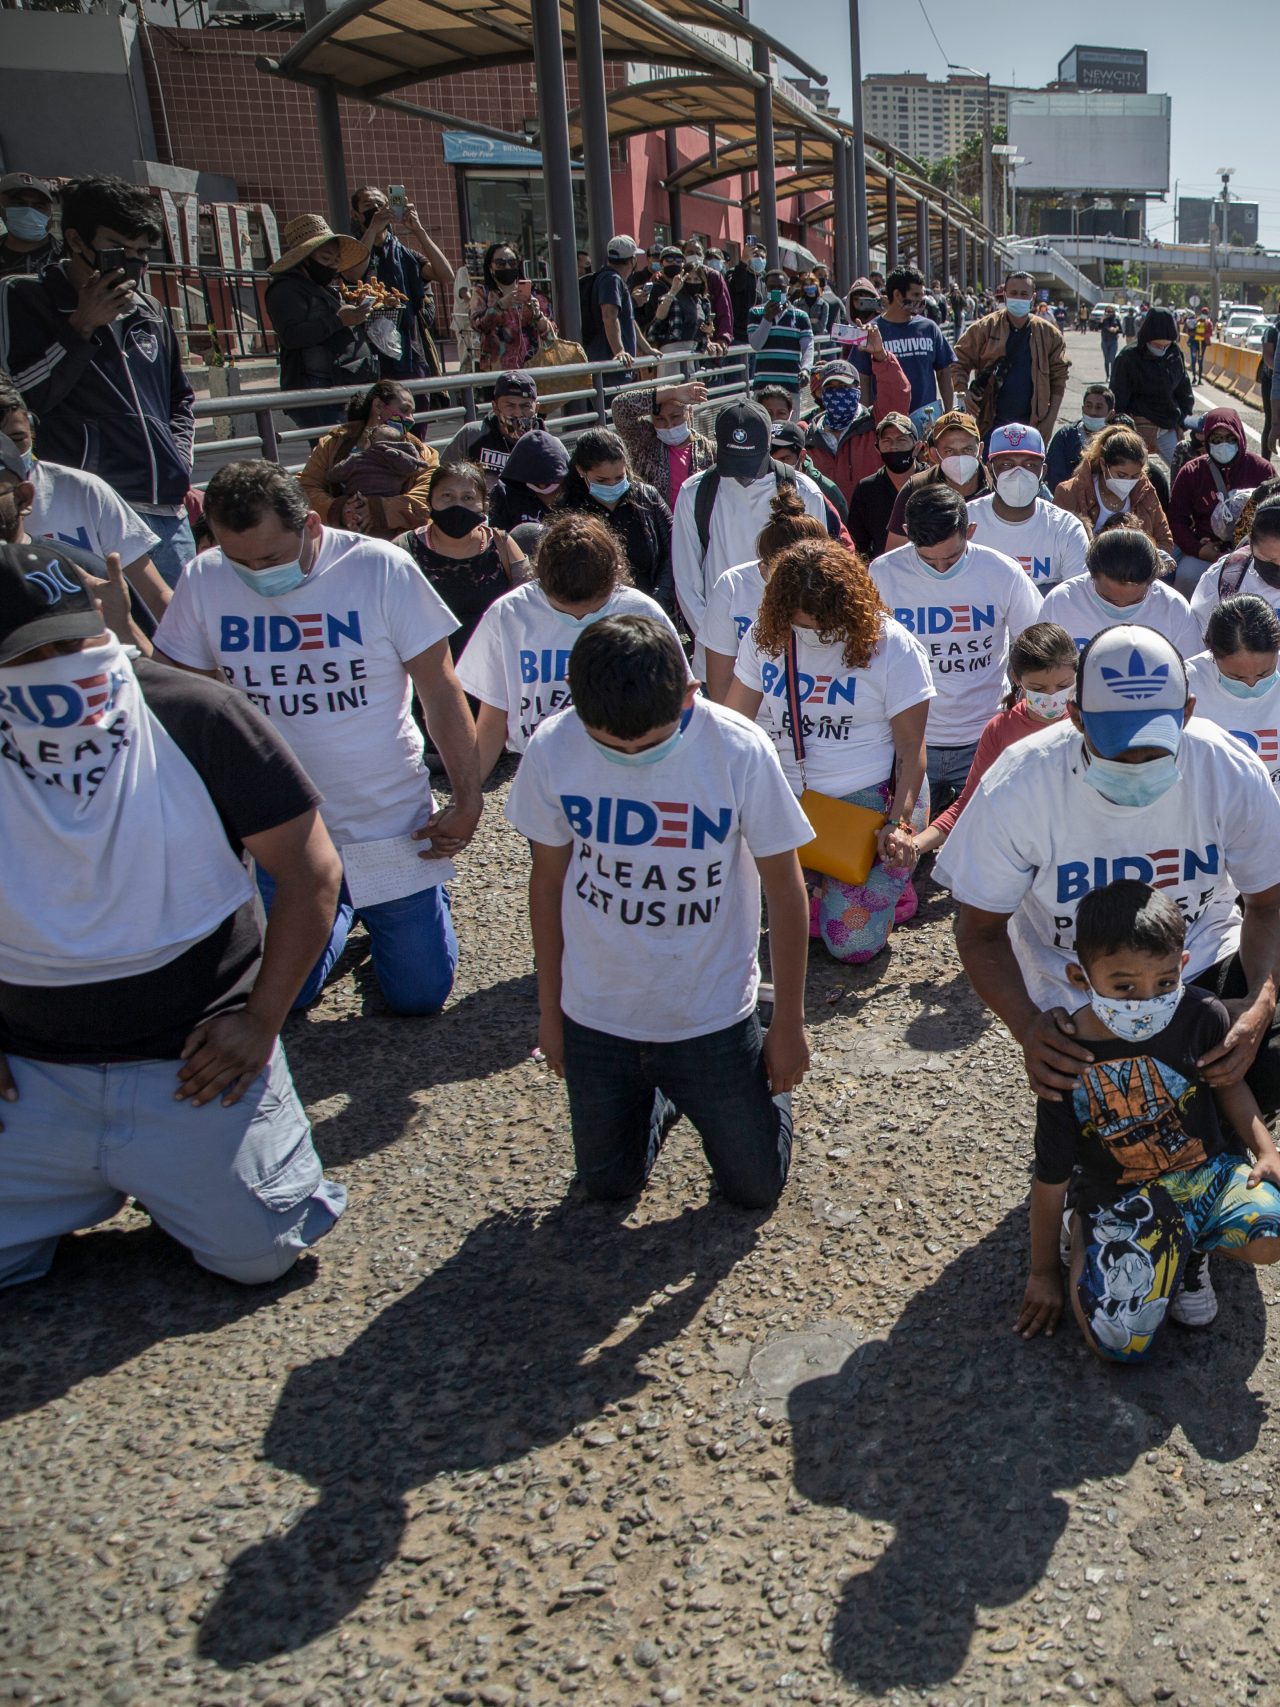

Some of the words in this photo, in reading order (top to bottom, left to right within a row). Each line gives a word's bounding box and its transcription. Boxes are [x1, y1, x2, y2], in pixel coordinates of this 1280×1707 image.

[884, 338, 934, 353] URVIVOR
[220, 611, 363, 653] BIDEN
[894, 605, 995, 635] BIDEN
[222, 659, 367, 687] PLEASE
[279, 693, 319, 717] US
[327, 685, 369, 713] IN!
[560, 794, 732, 850] BIDEN
[579, 842, 722, 893] PLEASE
[1057, 843, 1220, 904] BIDEN
[620, 898, 667, 927] US
